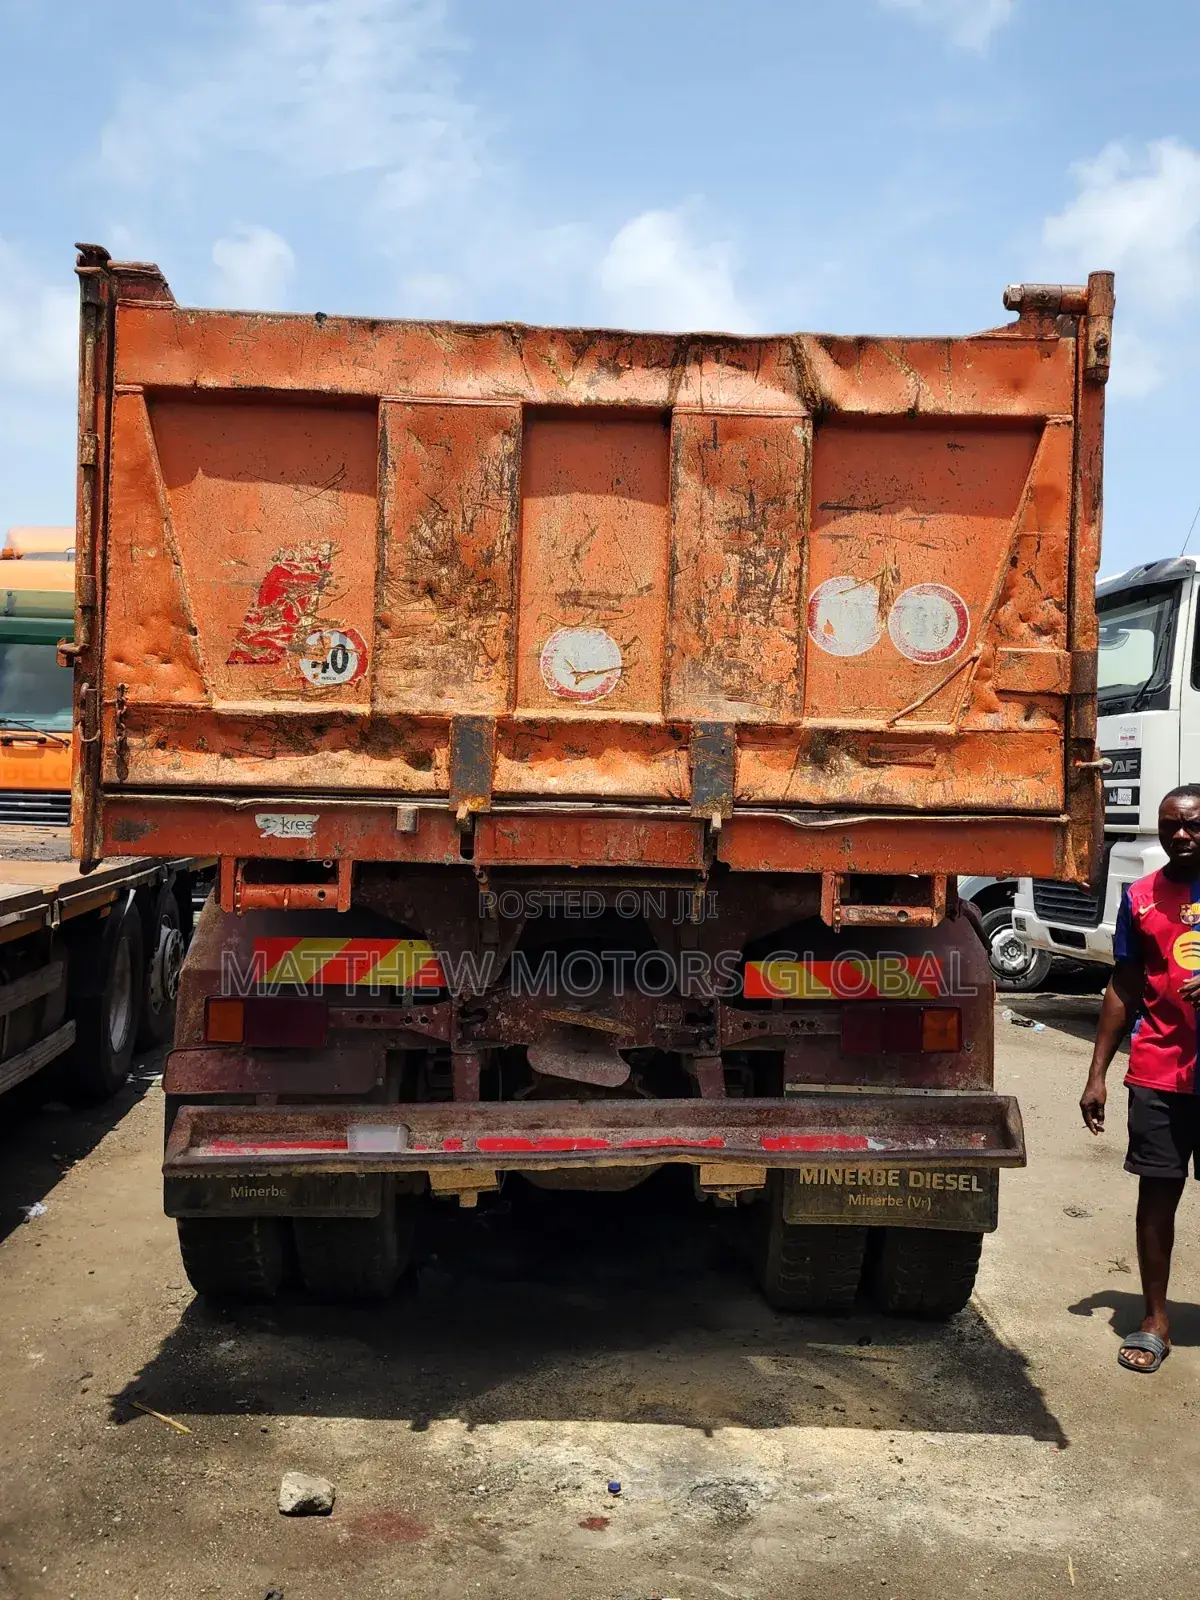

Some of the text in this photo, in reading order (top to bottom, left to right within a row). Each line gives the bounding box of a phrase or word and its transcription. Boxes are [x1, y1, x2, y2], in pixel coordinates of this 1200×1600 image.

[799, 1168, 984, 1193] MINERBE DIESEL
[230, 1184, 287, 1199] Minerbe
[848, 1193, 932, 1212] Minerbe (Vr)
